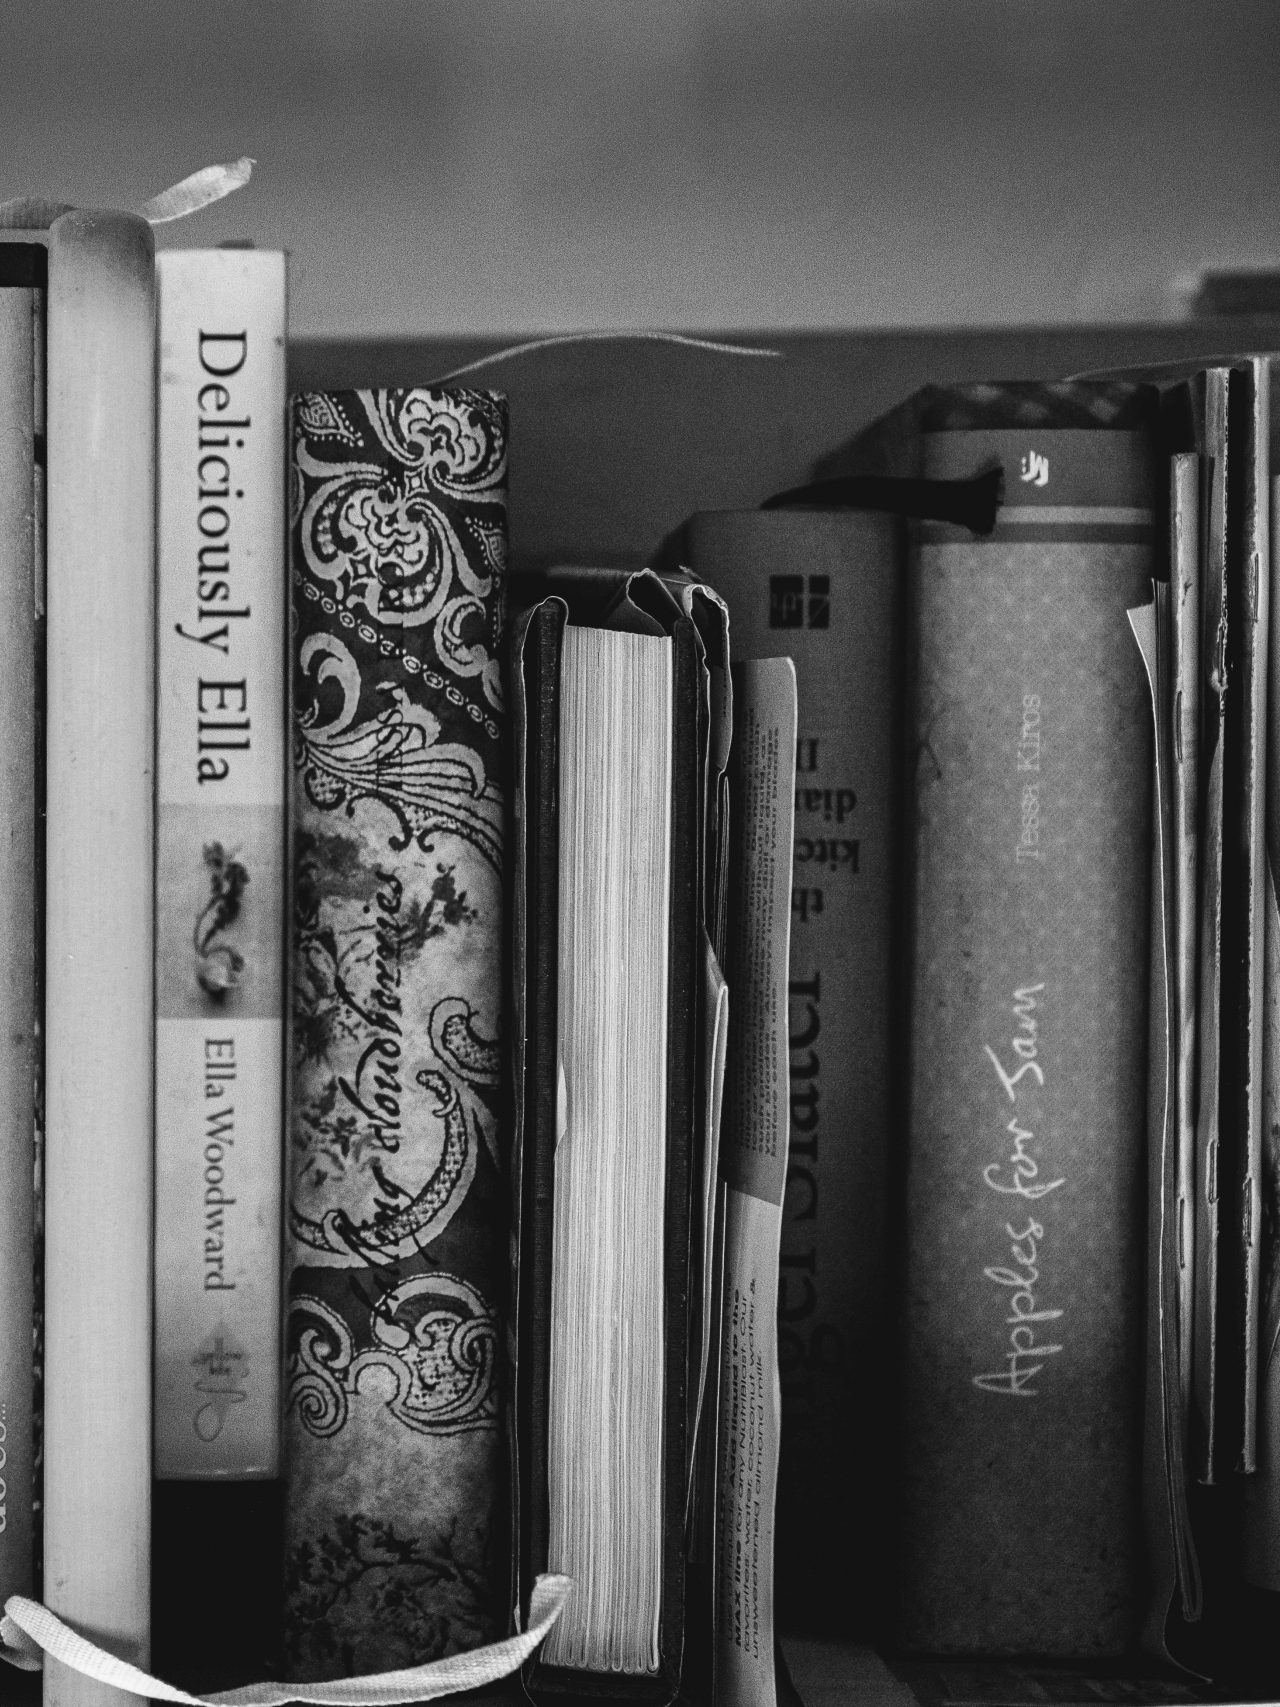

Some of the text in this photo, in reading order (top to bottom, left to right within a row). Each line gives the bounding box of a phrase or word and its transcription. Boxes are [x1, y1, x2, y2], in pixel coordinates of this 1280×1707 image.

[175, 332, 250, 784] Deliciously Ella
[794, 839, 861, 874] kitc
[1015, 694, 1042, 863] Tessa Kiros
[204, 1039, 236, 1291] Ella Woodward
[972, 983, 1065, 1396] Apples for Jam
[733, 1334, 738, 1356] to
[755, 1405, 764, 1495] almond
[752, 1500, 760, 1659] unsweetened
